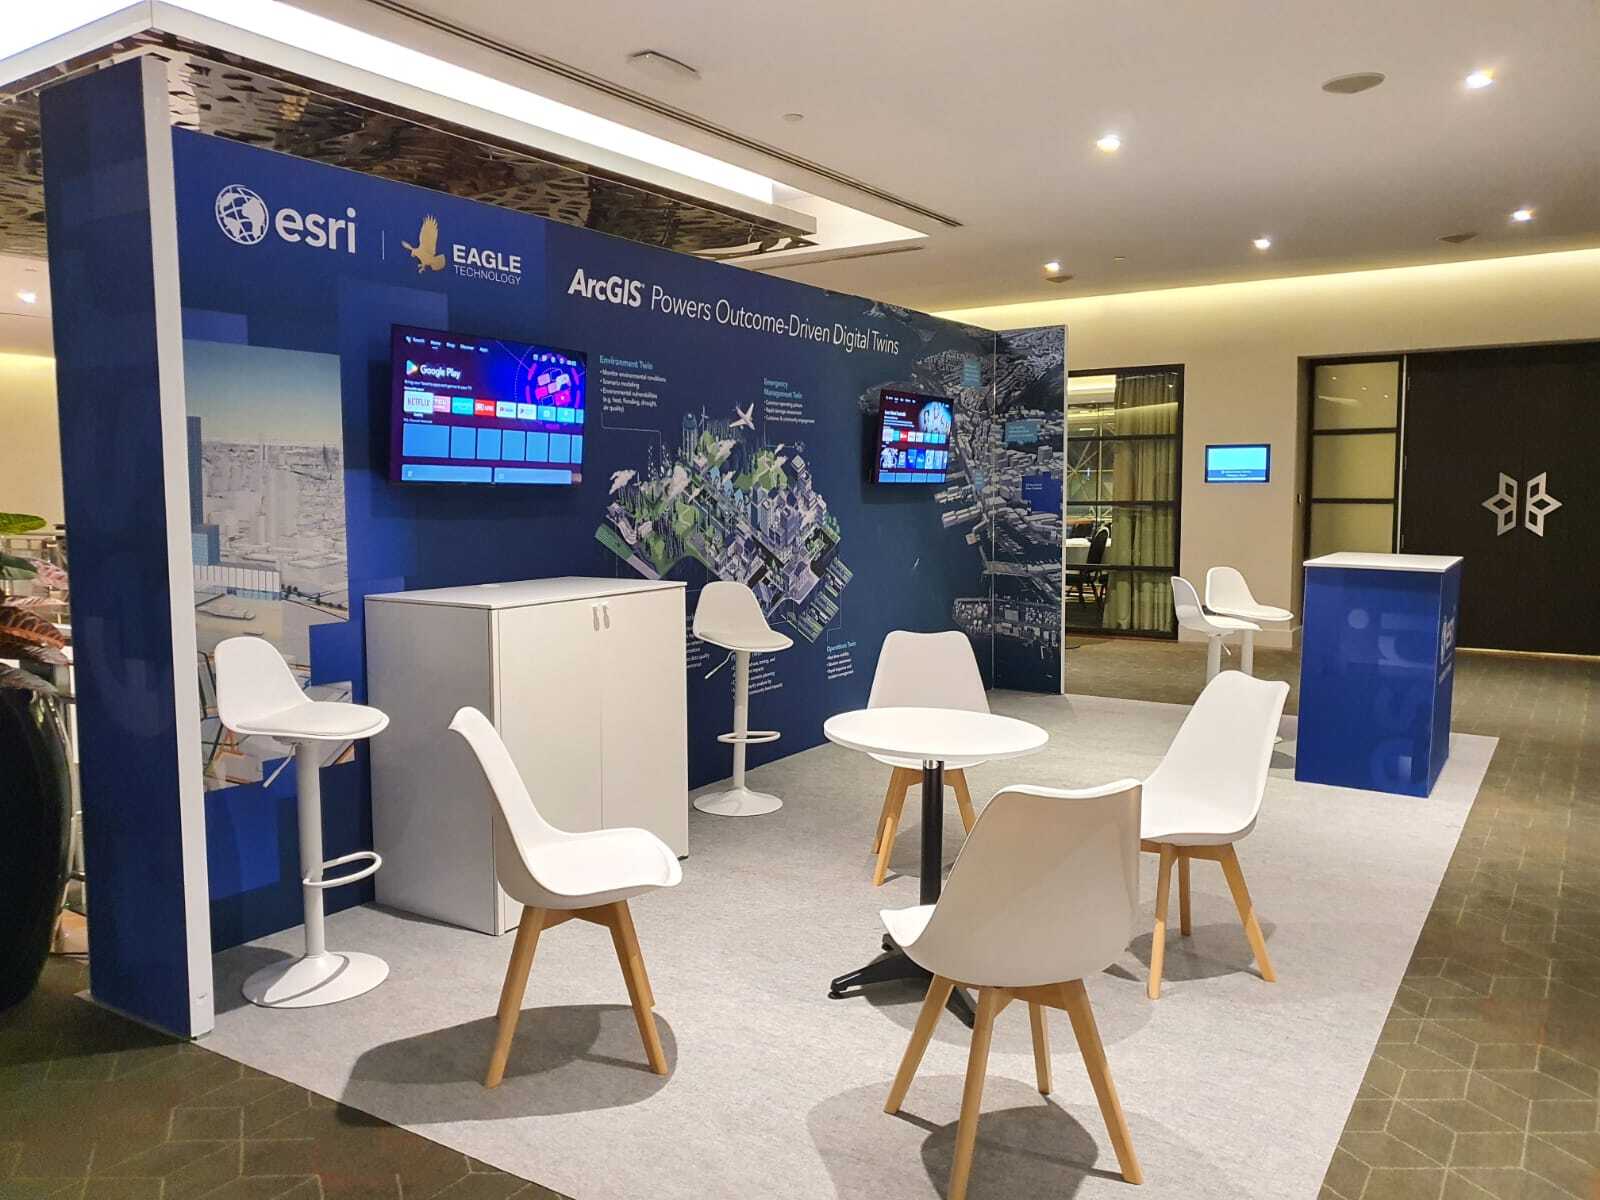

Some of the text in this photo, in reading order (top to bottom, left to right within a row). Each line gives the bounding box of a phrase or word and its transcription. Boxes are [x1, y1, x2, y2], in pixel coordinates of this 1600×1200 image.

[275, 207, 356, 254] esri
[452, 244, 521, 273] EAGLE
[454, 264, 521, 286] TECHNOLOGY
[568, 268, 899, 355] ArcGIS Powers Outcome-Driven Digital Twins
[420, 364, 462, 380] Google Play
[599, 355, 639, 369] Environment
